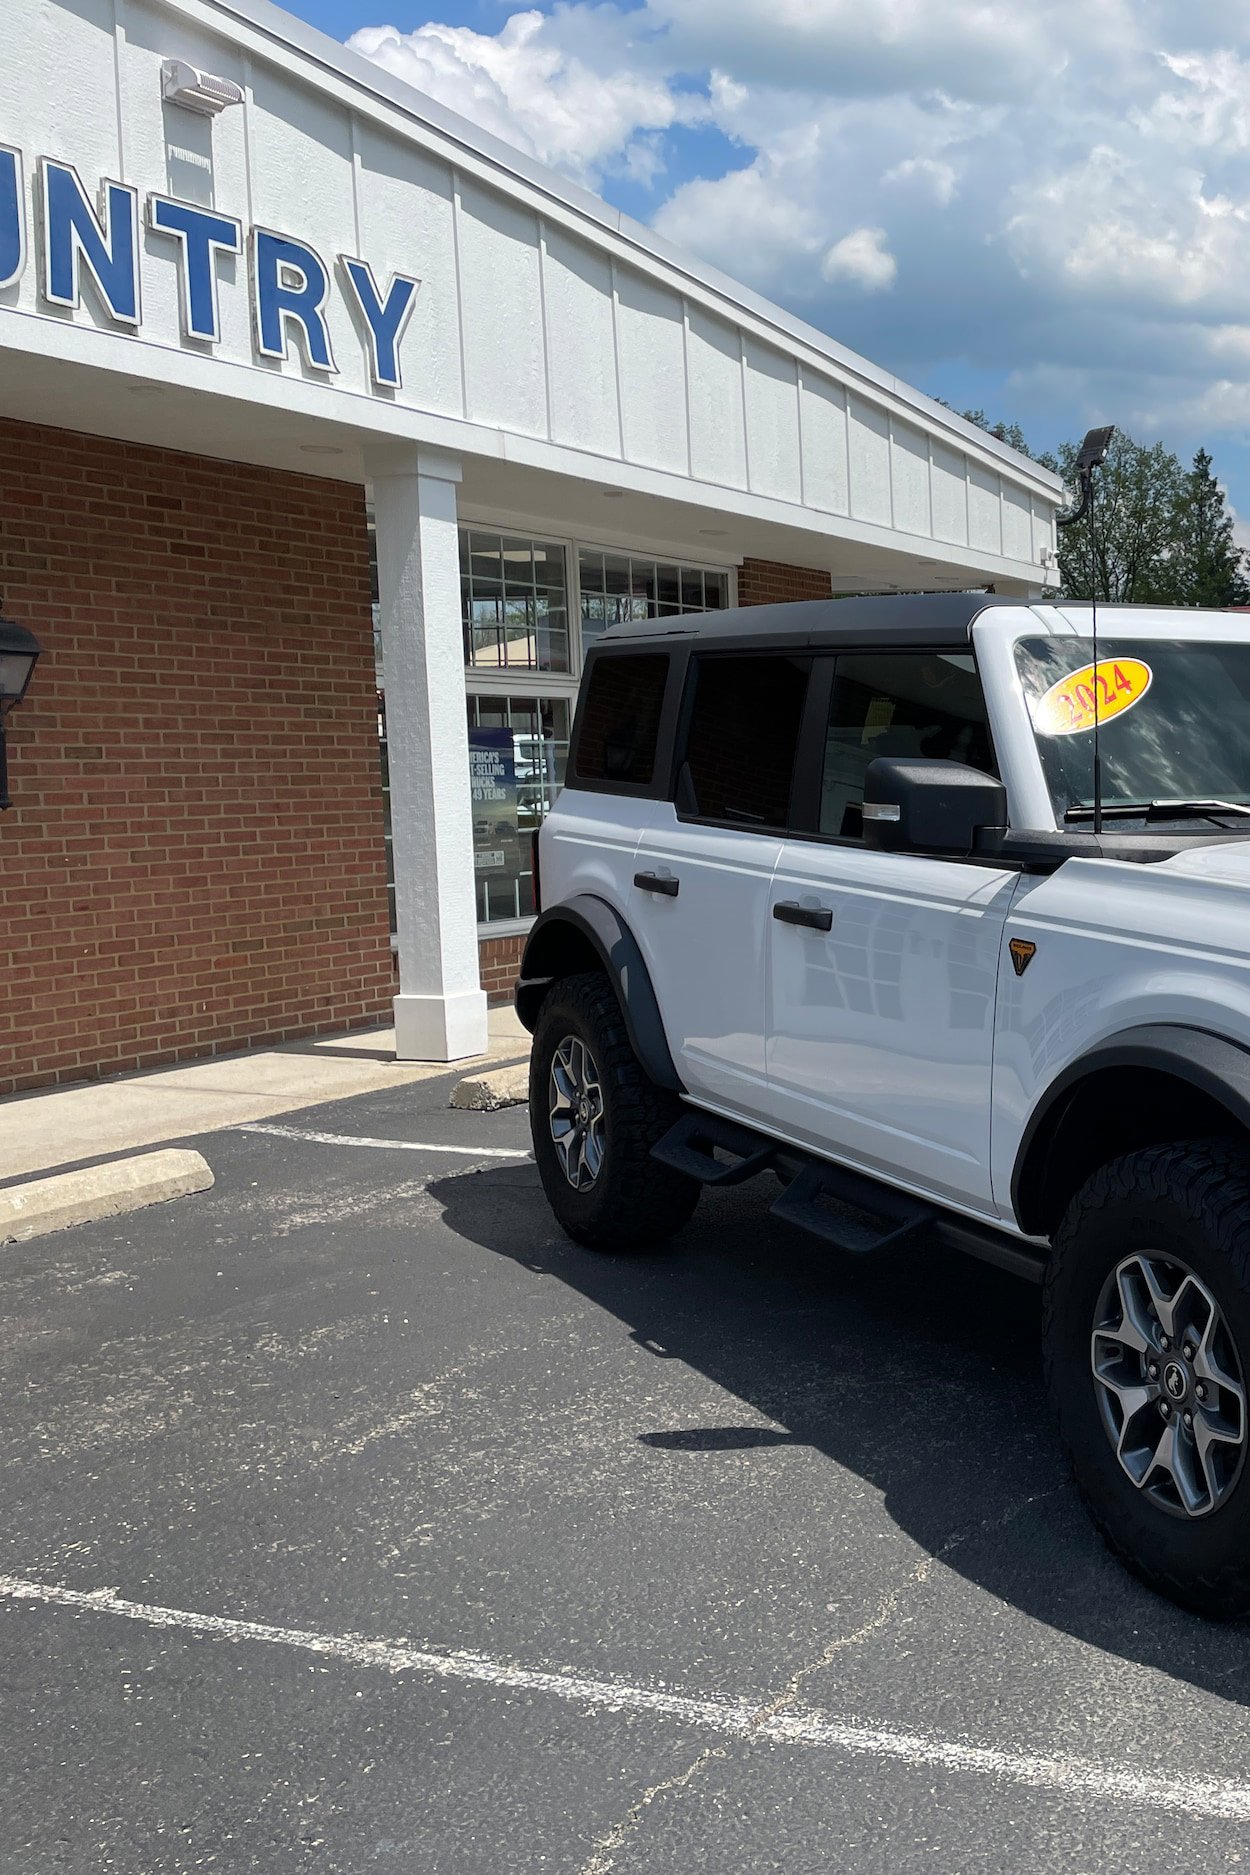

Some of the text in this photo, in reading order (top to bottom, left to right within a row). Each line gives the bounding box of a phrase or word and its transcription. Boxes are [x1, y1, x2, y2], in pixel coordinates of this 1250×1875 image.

[0, 142, 422, 389] NTRY
[1057, 664, 1133, 724] 2024
[470, 764, 505, 775] T-SELLING
[471, 776, 495, 787] RUCKS
[473, 788, 506, 801] 49 YEARS
